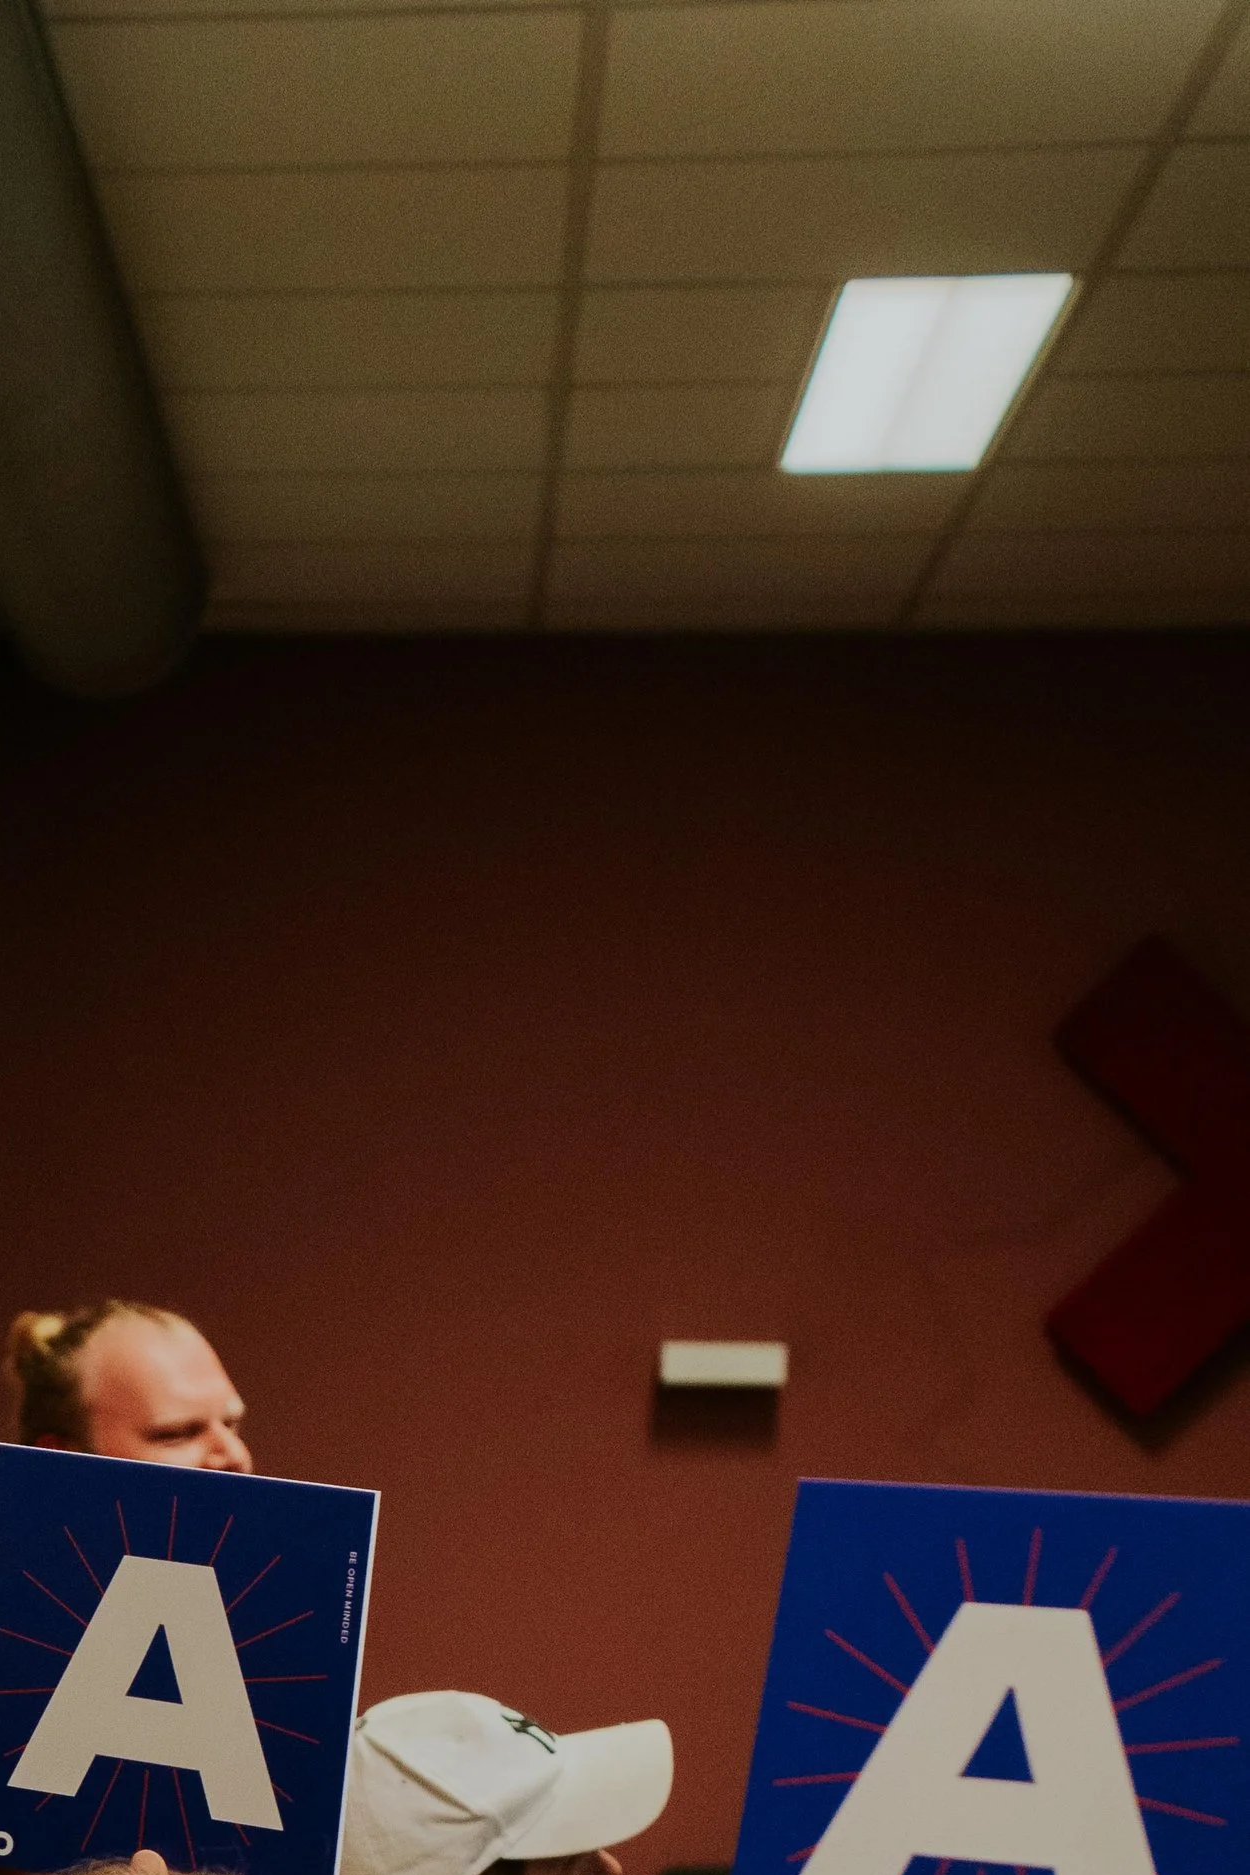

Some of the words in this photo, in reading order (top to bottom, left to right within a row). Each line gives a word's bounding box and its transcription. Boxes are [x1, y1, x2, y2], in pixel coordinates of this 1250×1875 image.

[349, 1551, 358, 1565] BE
[345, 1568, 355, 1598] OPEN
[340, 1600, 352, 1644] MINDED
[7, 1555, 283, 1831] A
